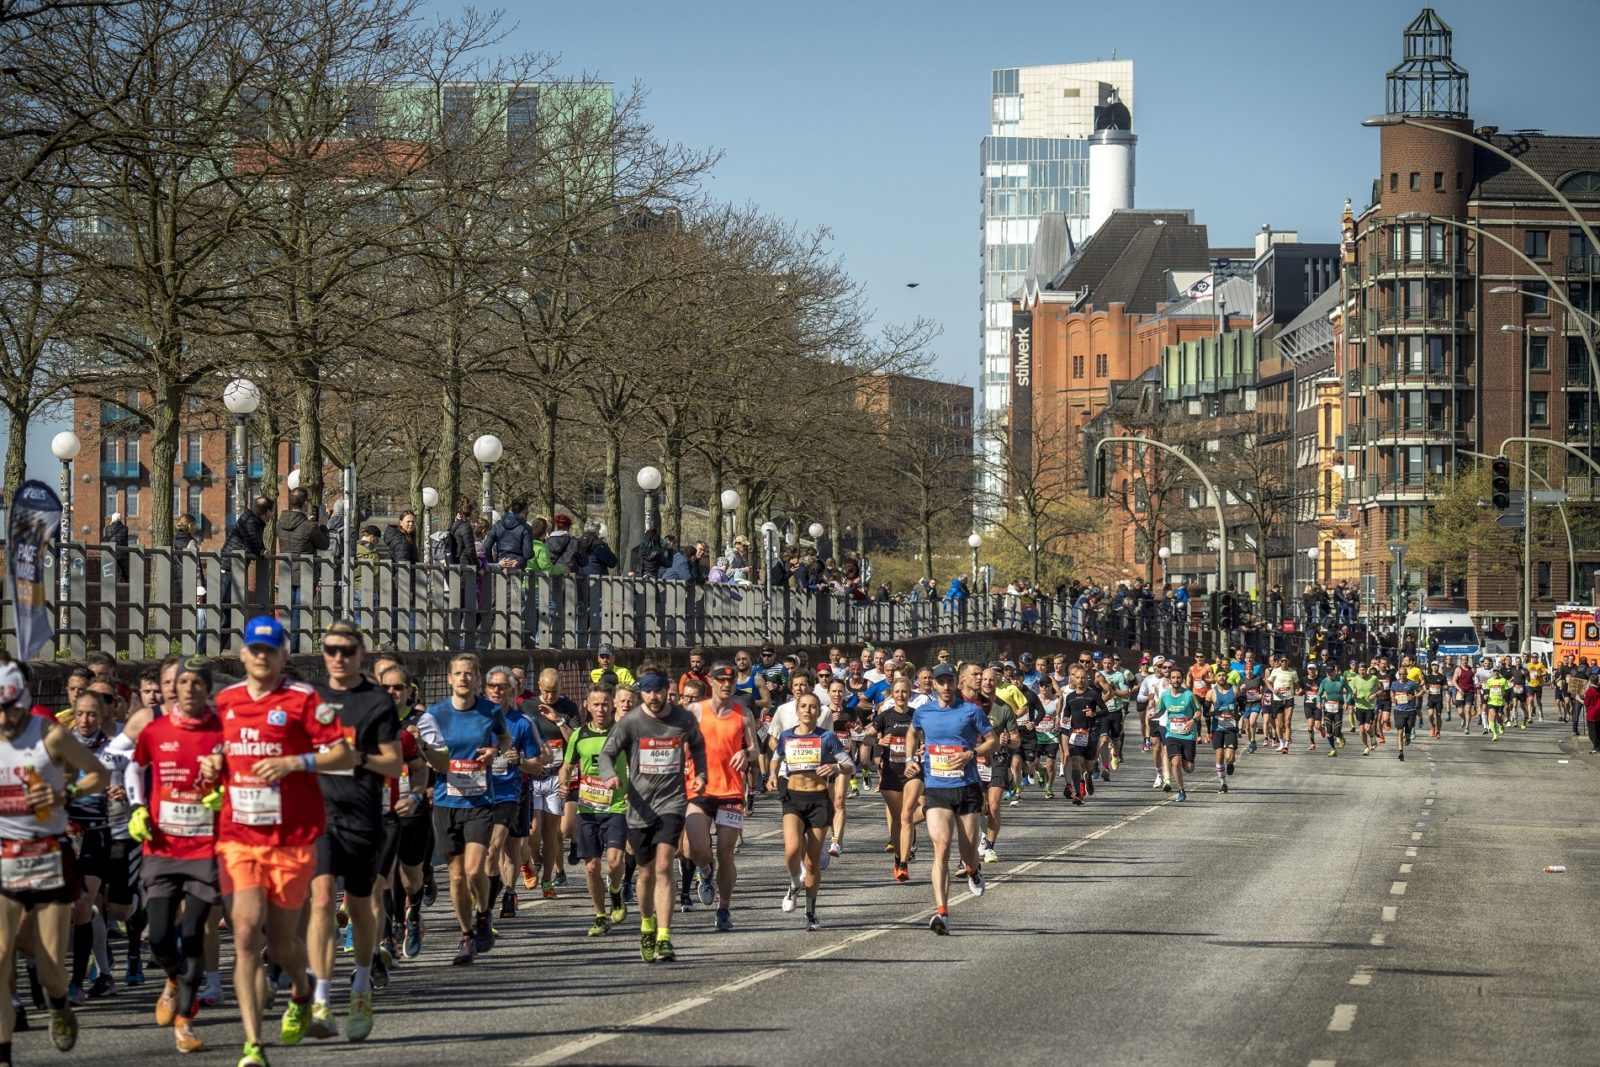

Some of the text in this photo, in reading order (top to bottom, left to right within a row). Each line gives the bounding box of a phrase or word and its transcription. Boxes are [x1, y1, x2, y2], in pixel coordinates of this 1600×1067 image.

[1014, 327, 1030, 387] stilwerk
[240, 727, 259, 741] Fly
[650, 750, 670, 758] 4046
[586, 787, 604, 796] 22083
[174, 805, 197, 813] 4141
